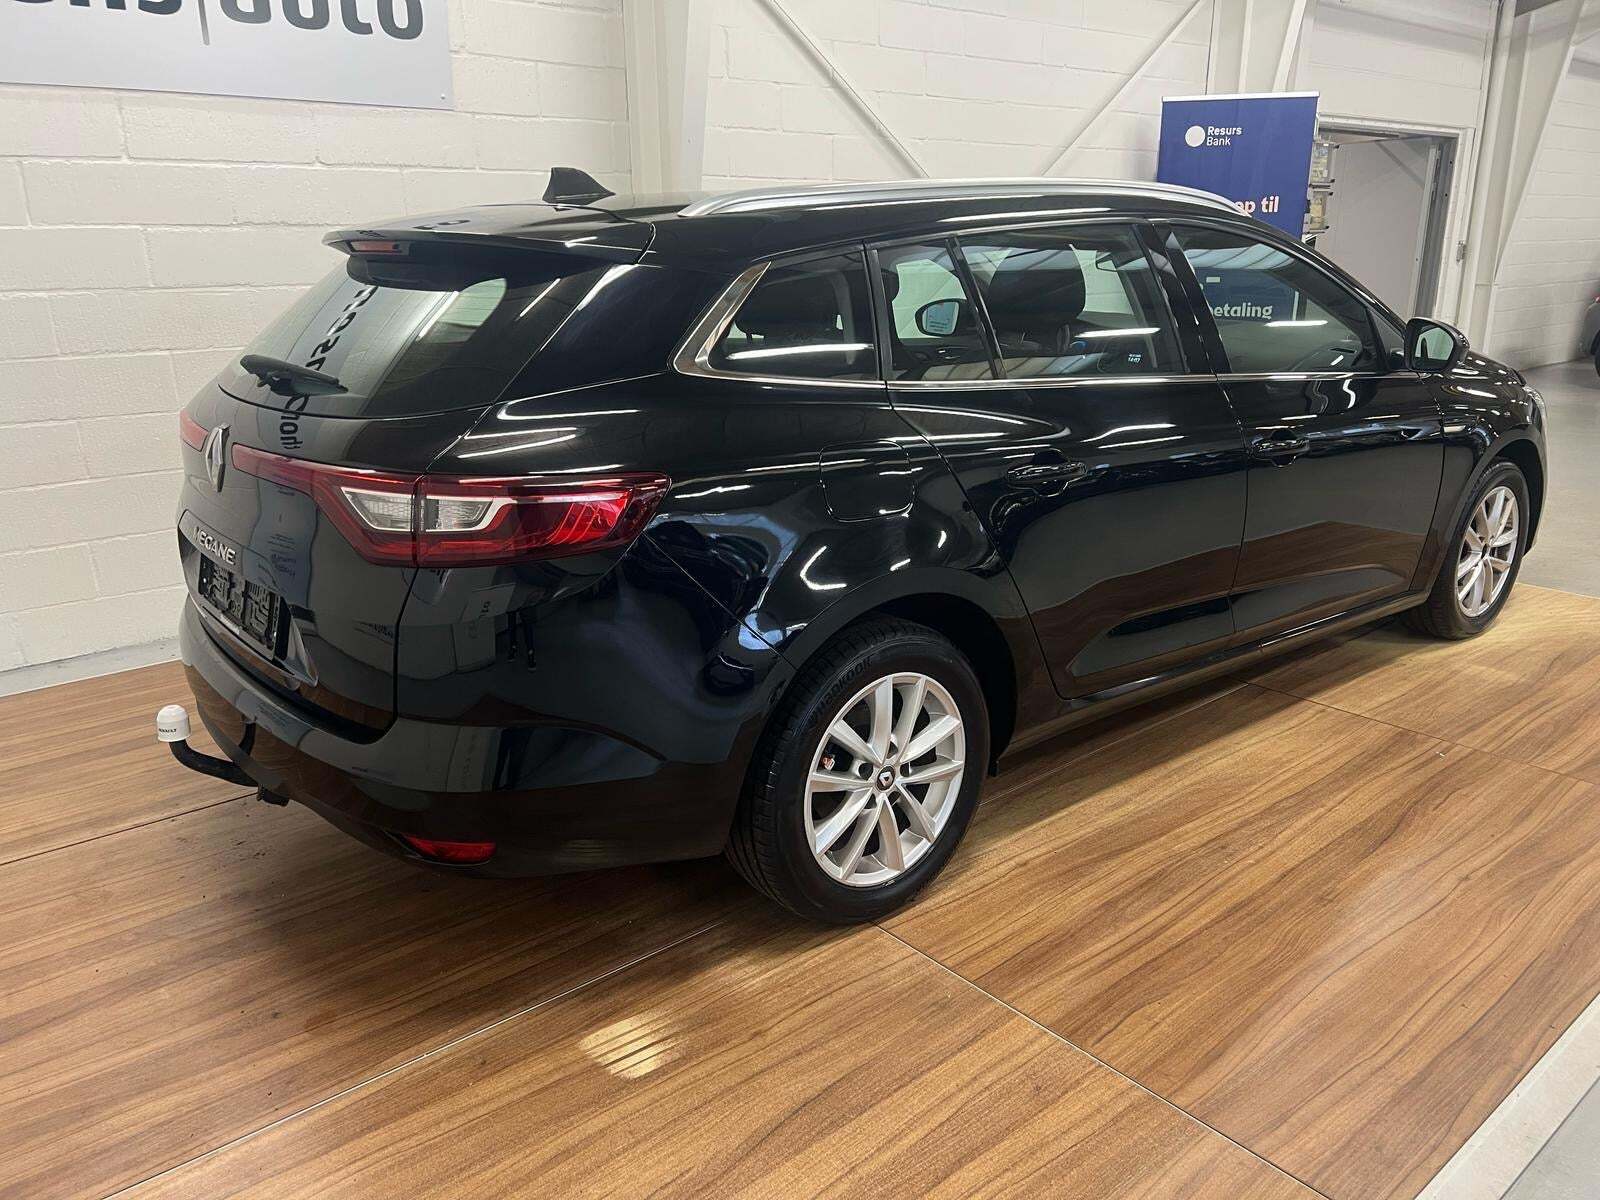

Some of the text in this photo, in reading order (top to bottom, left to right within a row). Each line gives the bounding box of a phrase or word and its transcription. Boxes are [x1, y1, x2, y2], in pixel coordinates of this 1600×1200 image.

[1207, 126, 1242, 136] Resurs
[1206, 136, 1231, 146] Bank
[1261, 195, 1280, 213] til
